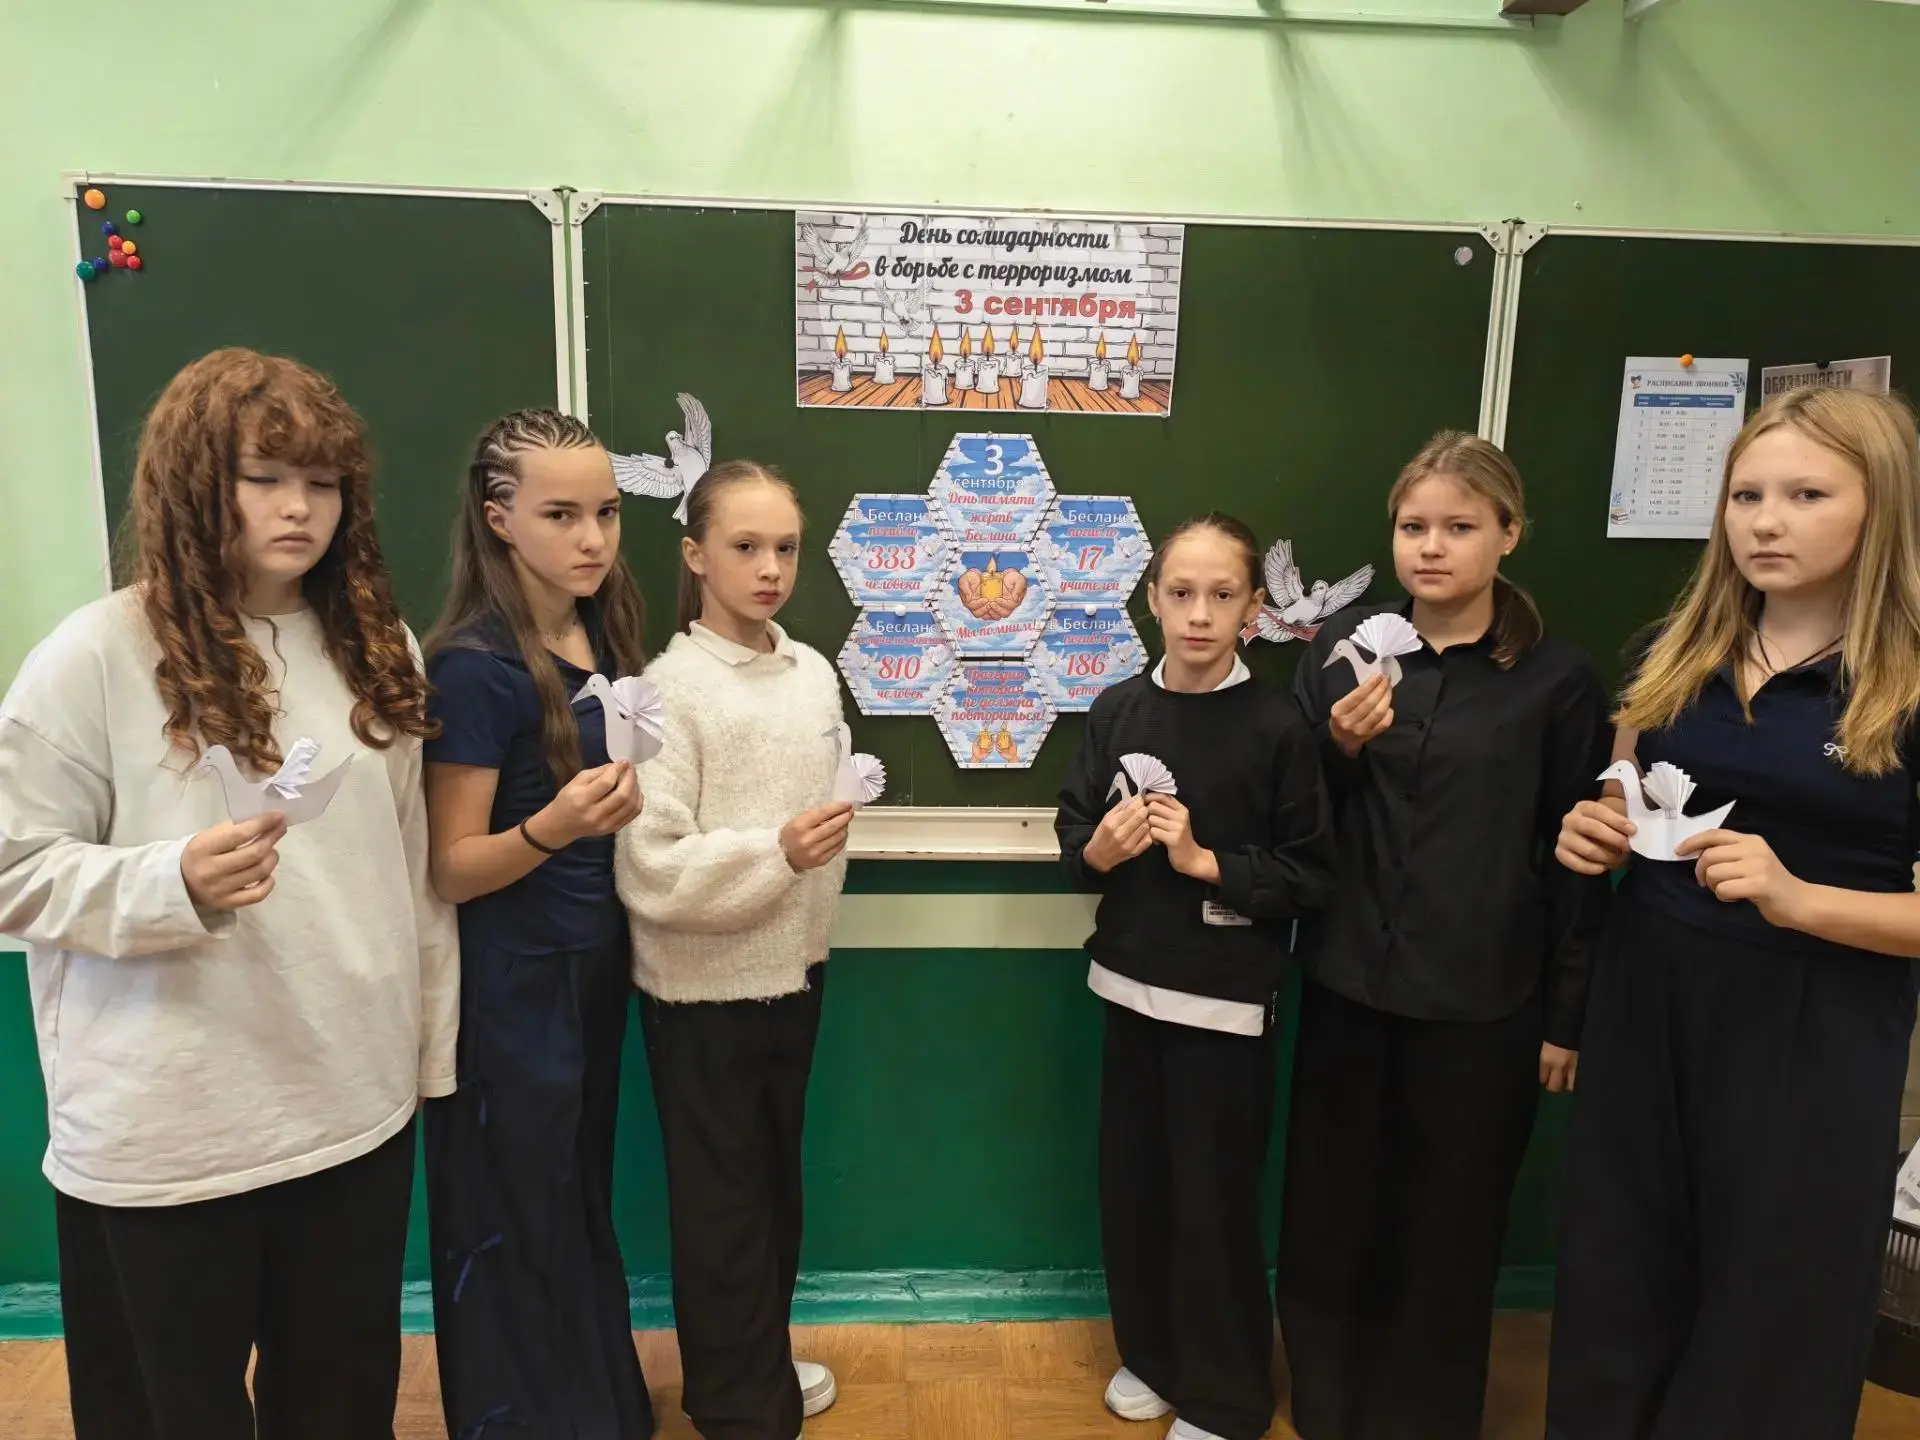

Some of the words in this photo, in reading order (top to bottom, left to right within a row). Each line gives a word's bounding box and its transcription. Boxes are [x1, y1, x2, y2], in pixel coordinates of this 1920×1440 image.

[900, 221, 951, 244] День
[956, 228, 1110, 252] солидарности
[874, 255, 889, 277] в
[892, 257, 960, 283] борьбе
[963, 264, 975, 278] с
[977, 264, 1133, 288] терроризмом
[954, 289, 974, 314] 3
[983, 293, 1136, 323] сентября
[984, 444, 1004, 475] 3
[954, 476, 1024, 491] сентября
[948, 492, 977, 504] День
[980, 495, 1035, 504] памяти
[970, 511, 1013, 525] жертв
[965, 528, 1017, 541] Беслана
[868, 545, 915, 569] 333
[1077, 546, 1105, 571] 17
[866, 580, 921, 590] человека
[1060, 581, 1120, 593] учителей
[957, 627, 977, 639] Мы
[878, 655, 921, 680] 810
[1066, 653, 1107, 676] 186
[877, 689, 924, 699] человек
[951, 710, 1045, 724] повториться!
